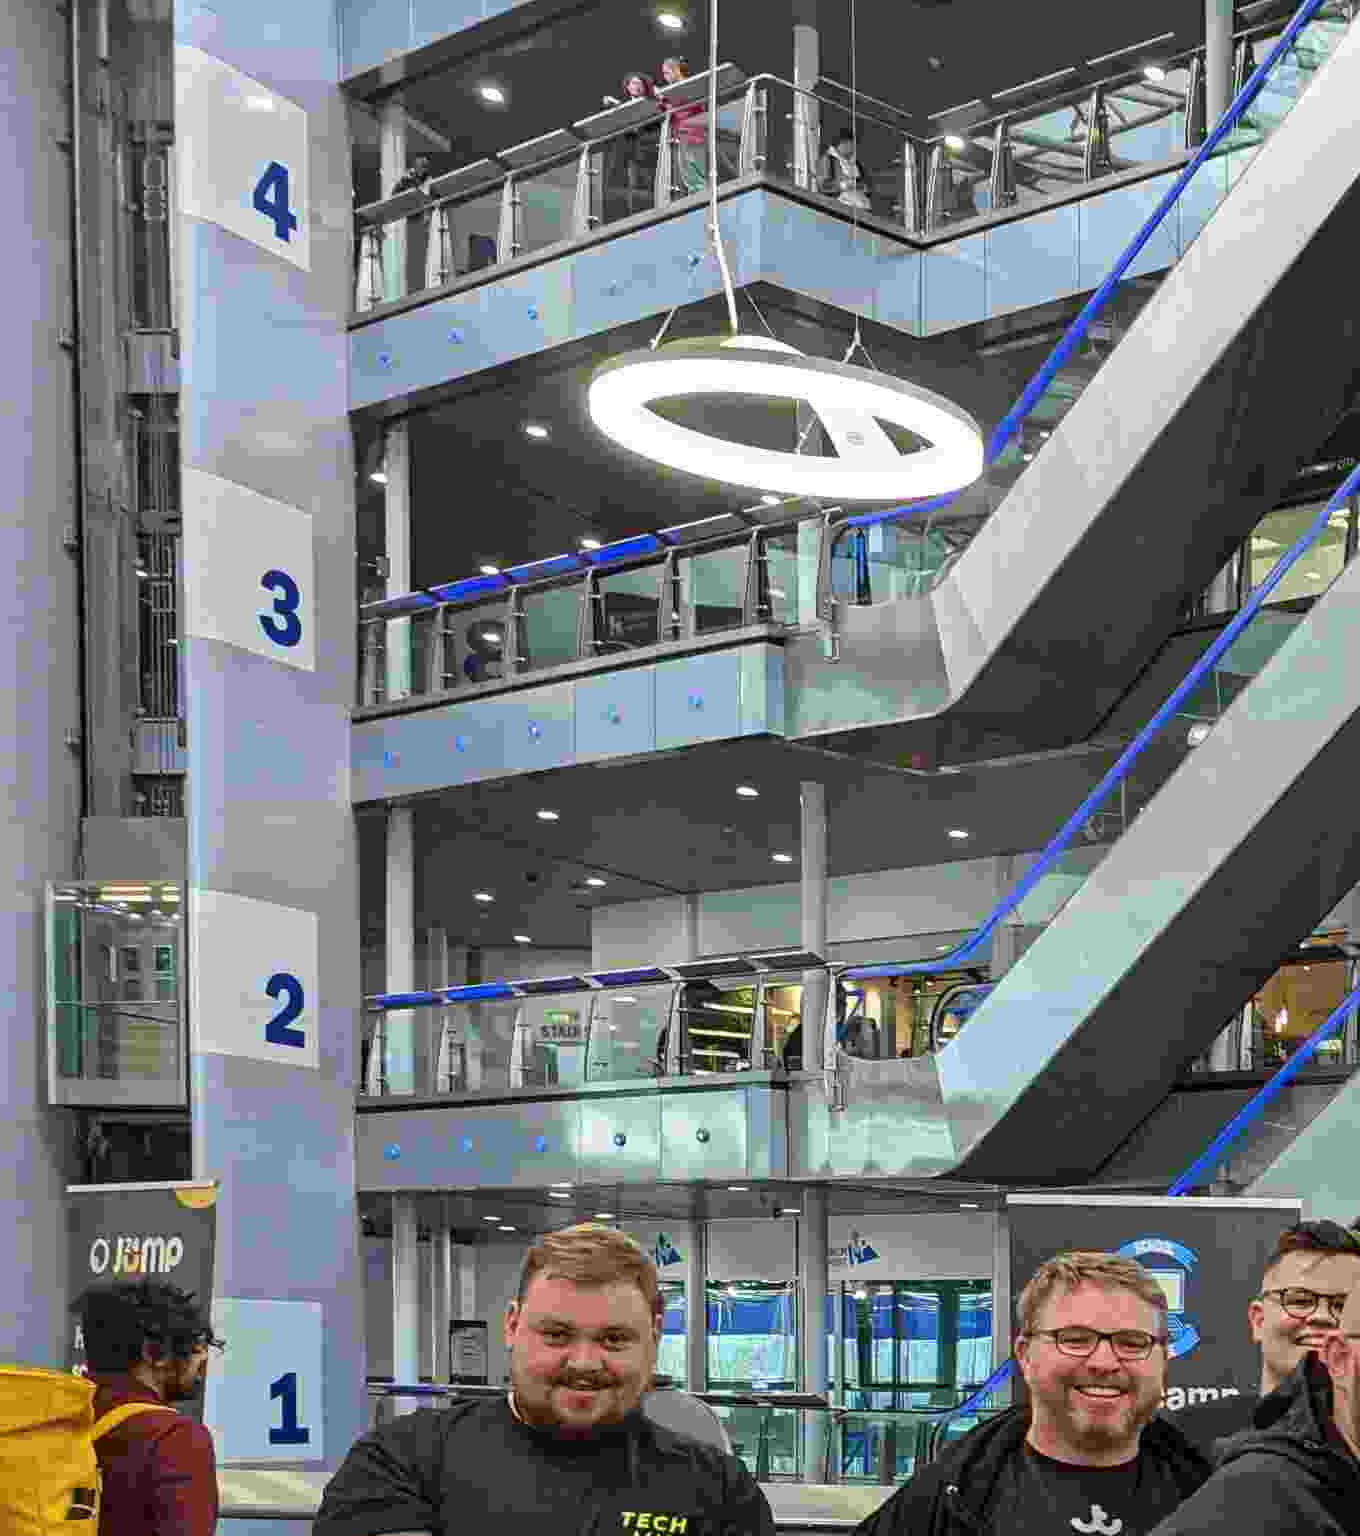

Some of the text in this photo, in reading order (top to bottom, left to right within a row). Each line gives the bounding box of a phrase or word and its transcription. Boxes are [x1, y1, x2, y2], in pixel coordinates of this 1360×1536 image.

[253, 160, 297, 241] 4
[260, 569, 303, 647] 3
[264, 972, 305, 1049] 2
[270, 1372, 309, 1444] 1
[621, 1510, 688, 1534] TECH
